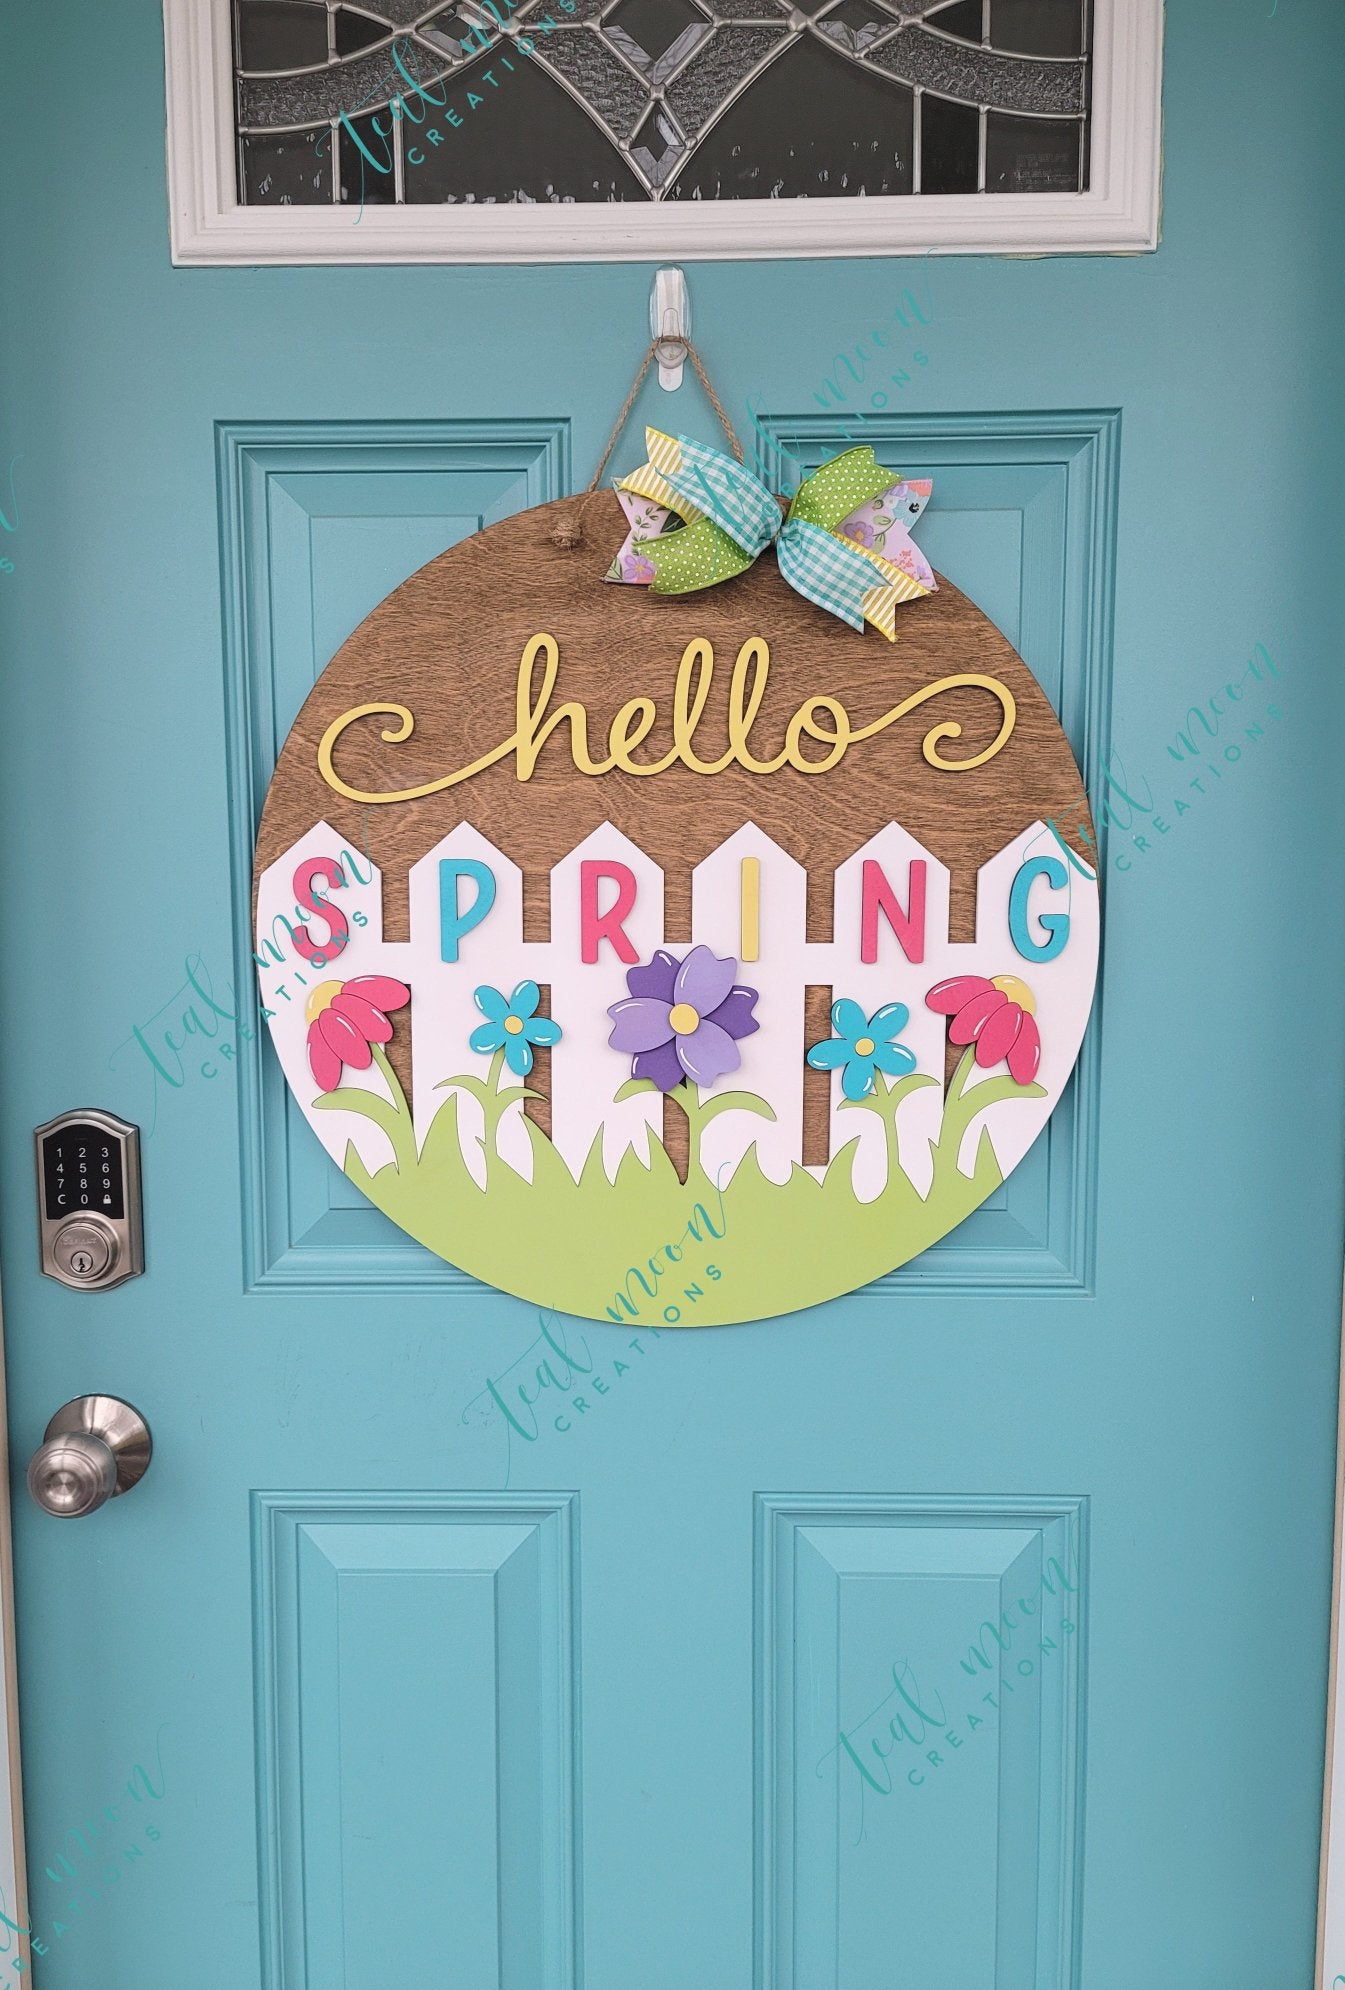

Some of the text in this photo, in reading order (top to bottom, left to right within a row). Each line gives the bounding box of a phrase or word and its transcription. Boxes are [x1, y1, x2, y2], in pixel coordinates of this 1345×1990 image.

[318, 633, 1017, 804] hello
[291, 856, 1072, 964] SPRING
[56, 1148, 109, 1158] 1 2 3
[56, 1163, 110, 1173] 4 5 6
[57, 1178, 111, 1188] 7 8 9
[57, 1194, 88, 1204] C 0
